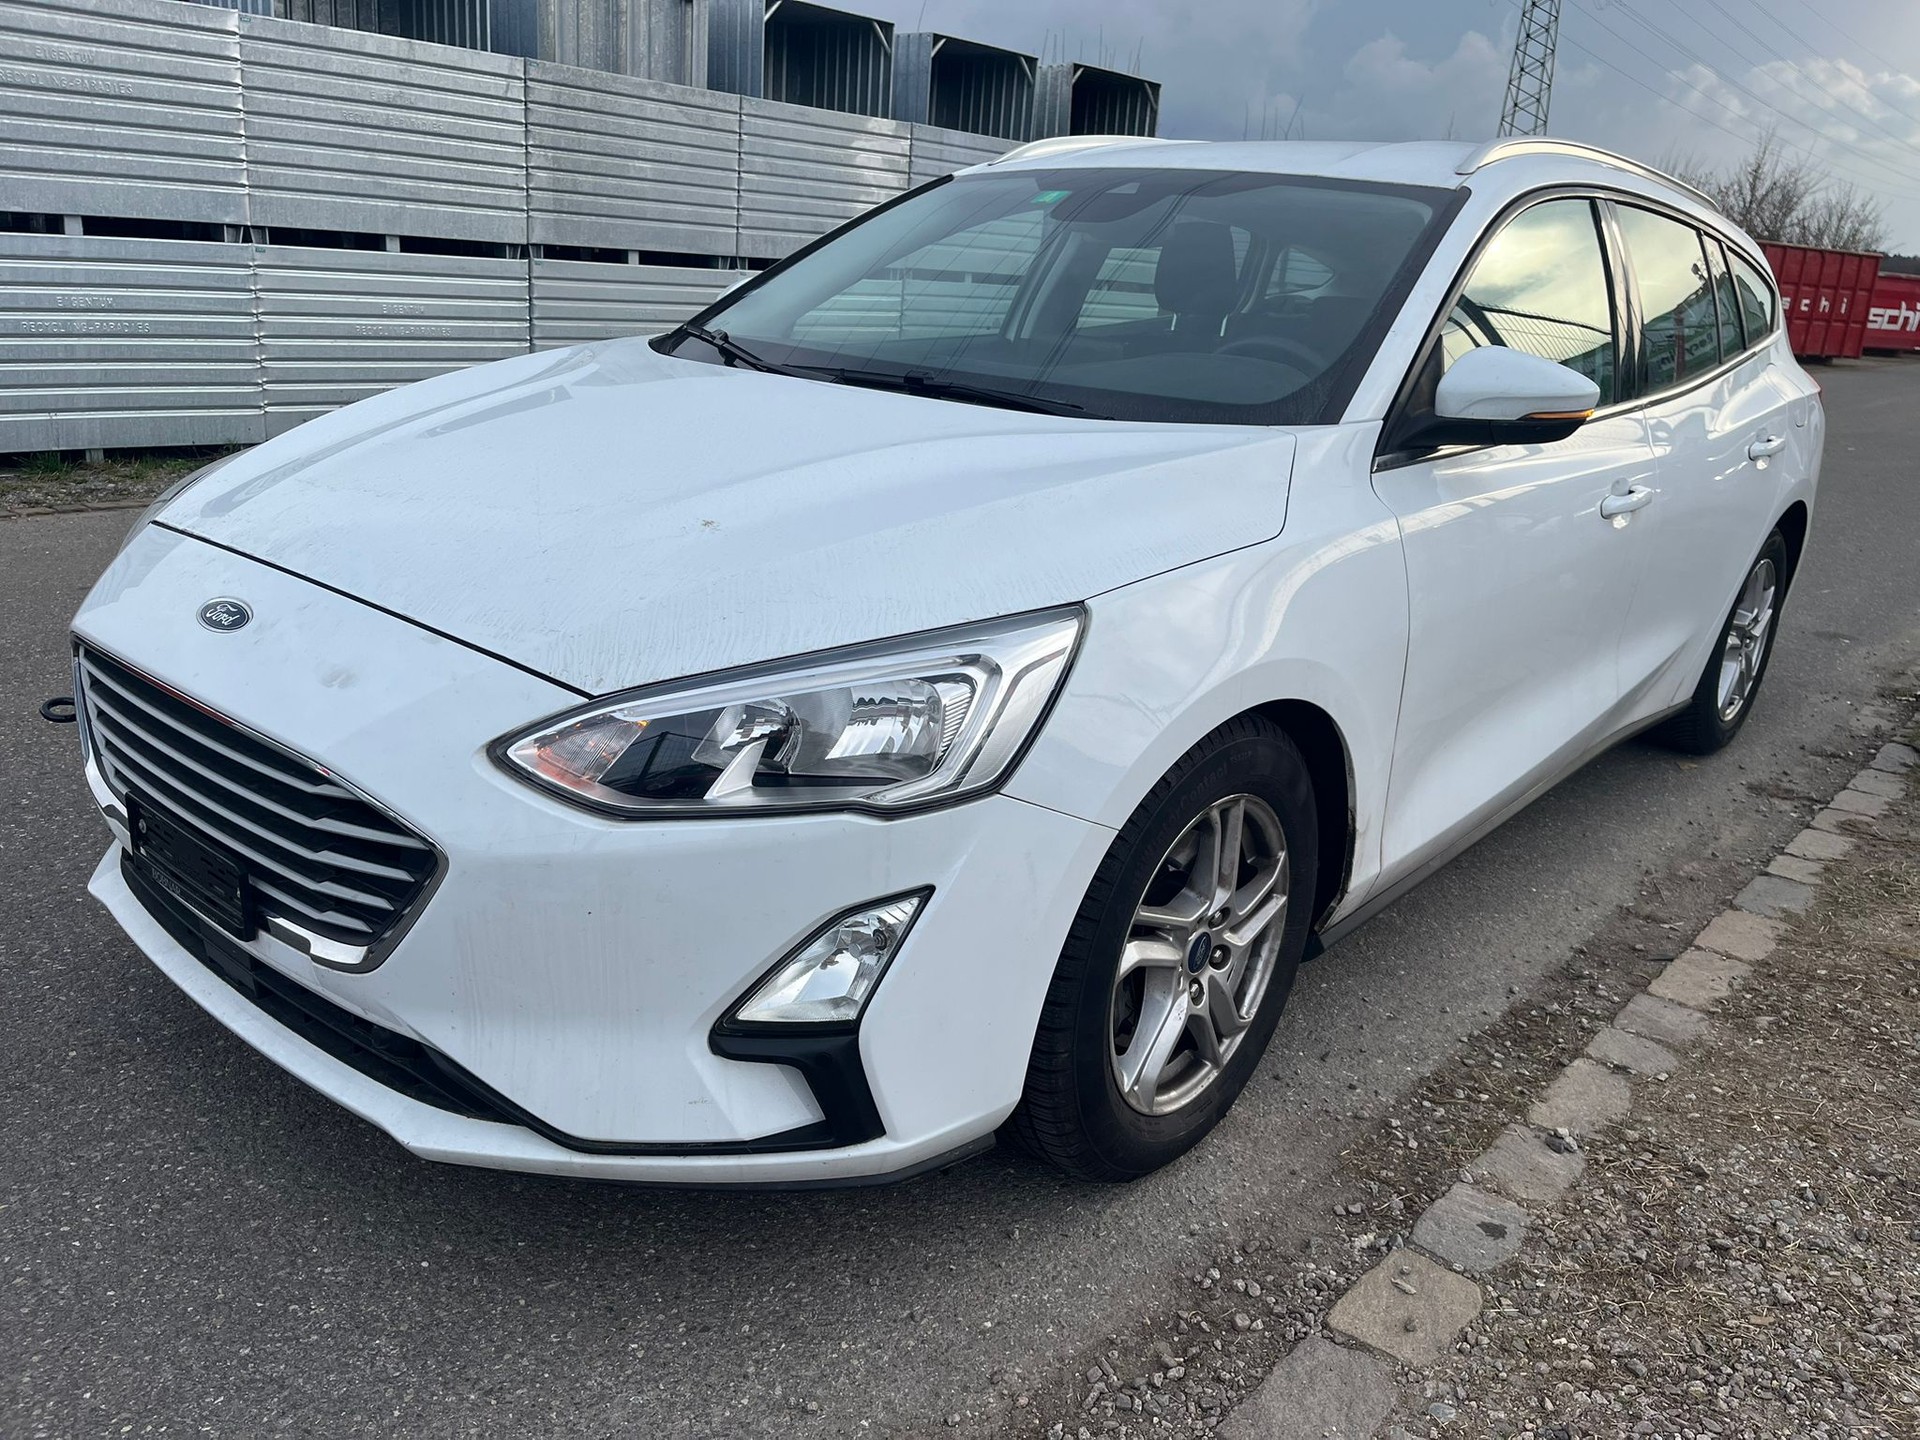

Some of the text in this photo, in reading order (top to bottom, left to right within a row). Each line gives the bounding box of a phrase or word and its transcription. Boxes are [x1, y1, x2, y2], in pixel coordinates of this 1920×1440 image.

[56, 296, 115, 307] EIGENTUM
[20, 321, 151, 333] RECYCLING-PARADIES
[205, 603, 241, 626] Ford
